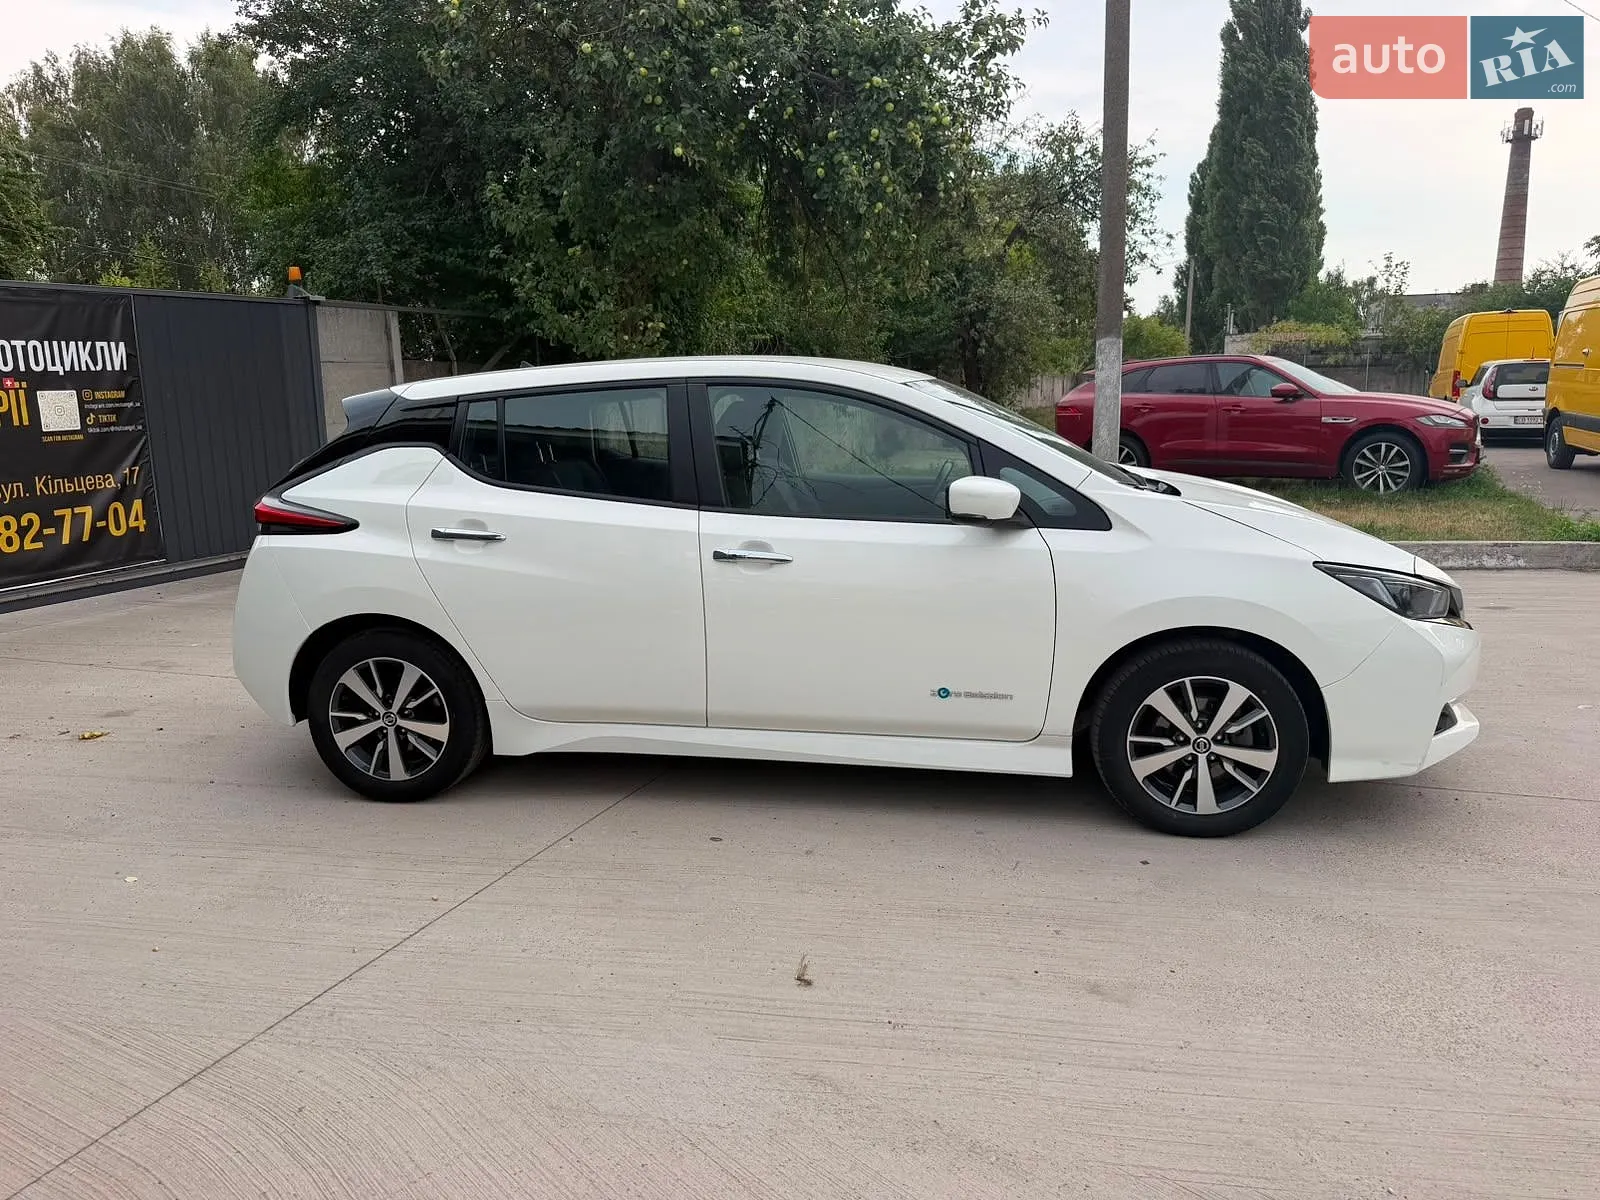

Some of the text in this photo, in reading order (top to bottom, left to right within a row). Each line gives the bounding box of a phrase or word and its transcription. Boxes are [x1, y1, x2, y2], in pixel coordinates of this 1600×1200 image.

[0, 466, 140, 504] ул. Кільцева, 17
[0, 498, 147, 553] 82-77-04
